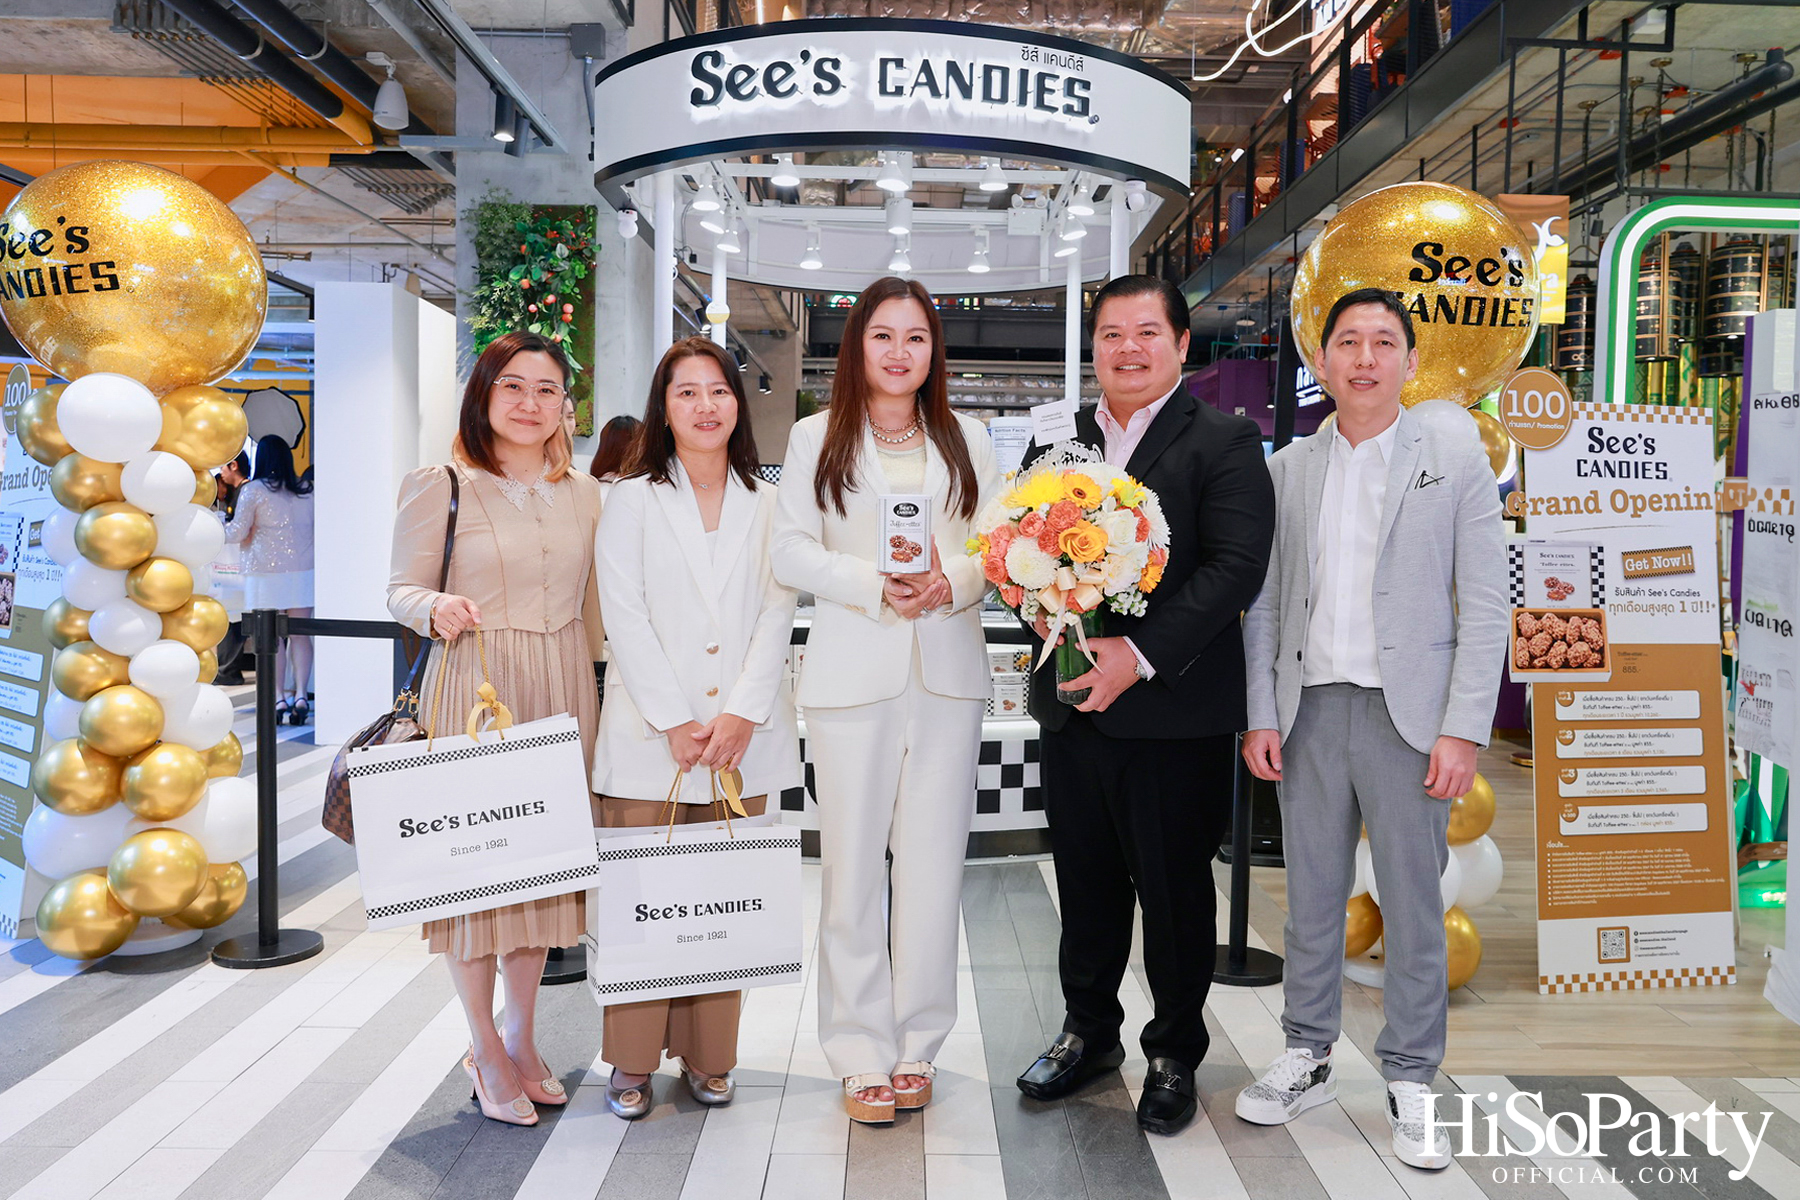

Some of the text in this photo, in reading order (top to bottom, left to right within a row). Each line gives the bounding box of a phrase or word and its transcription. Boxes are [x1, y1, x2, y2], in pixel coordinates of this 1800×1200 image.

[1043, 53, 1084, 72] แคนดีส์
[690, 49, 1092, 118] See's CANDIES
[1408, 241, 1525, 288] See's
[1398, 292, 1534, 328] ANDIES
[5, 381, 27, 407] 100
[1507, 389, 1566, 419] 100
[1536, 422, 1565, 430] Promotion
[1587, 426, 1656, 455] See's
[0, 466, 29, 492] rand
[1576, 458, 1668, 480] CANDIES
[1505, 490, 1602, 518] Grand
[1625, 552, 1693, 571] Get Now!!
[1614, 586, 1701, 597] รับสินค้า See's Candies
[1608, 600, 1675, 617] ทุกเดือนสูงสุด
[1679, 600, 1688, 613] 1
[399, 800, 546, 839] See's CANDIES
[450, 838, 509, 857] Since 1921
[635, 898, 762, 922] See's CANDIES
[676, 930, 728, 944] Since 1921
